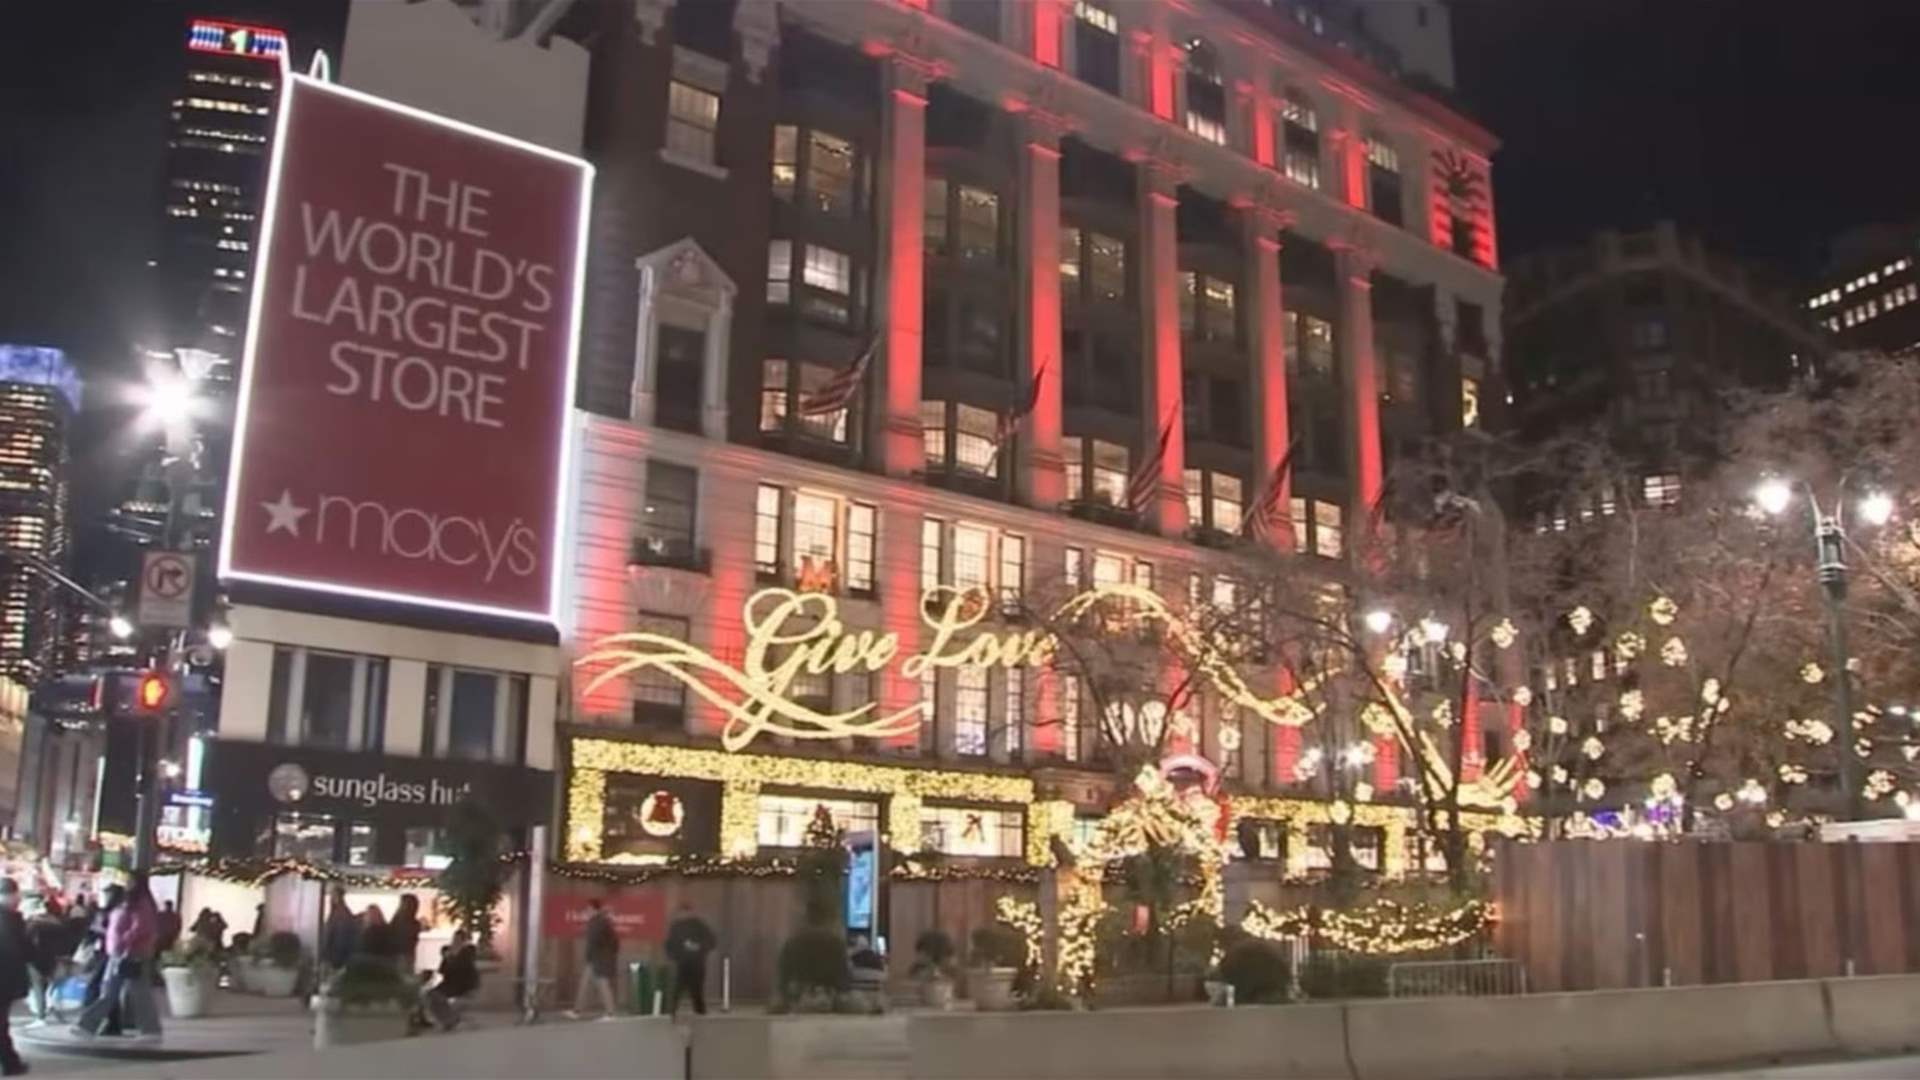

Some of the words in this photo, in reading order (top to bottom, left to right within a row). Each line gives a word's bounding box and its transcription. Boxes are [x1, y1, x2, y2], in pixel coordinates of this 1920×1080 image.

[229, 28, 248, 55] 1
[383, 161, 492, 238] THE
[301, 201, 555, 313] WORLD'S
[292, 264, 545, 371] LARGEST
[325, 340, 506, 428] STORE
[315, 494, 538, 583] macy's
[722, 587, 898, 751] Give
[901, 584, 1058, 678] Love
[313, 773, 426, 807] sunglass
